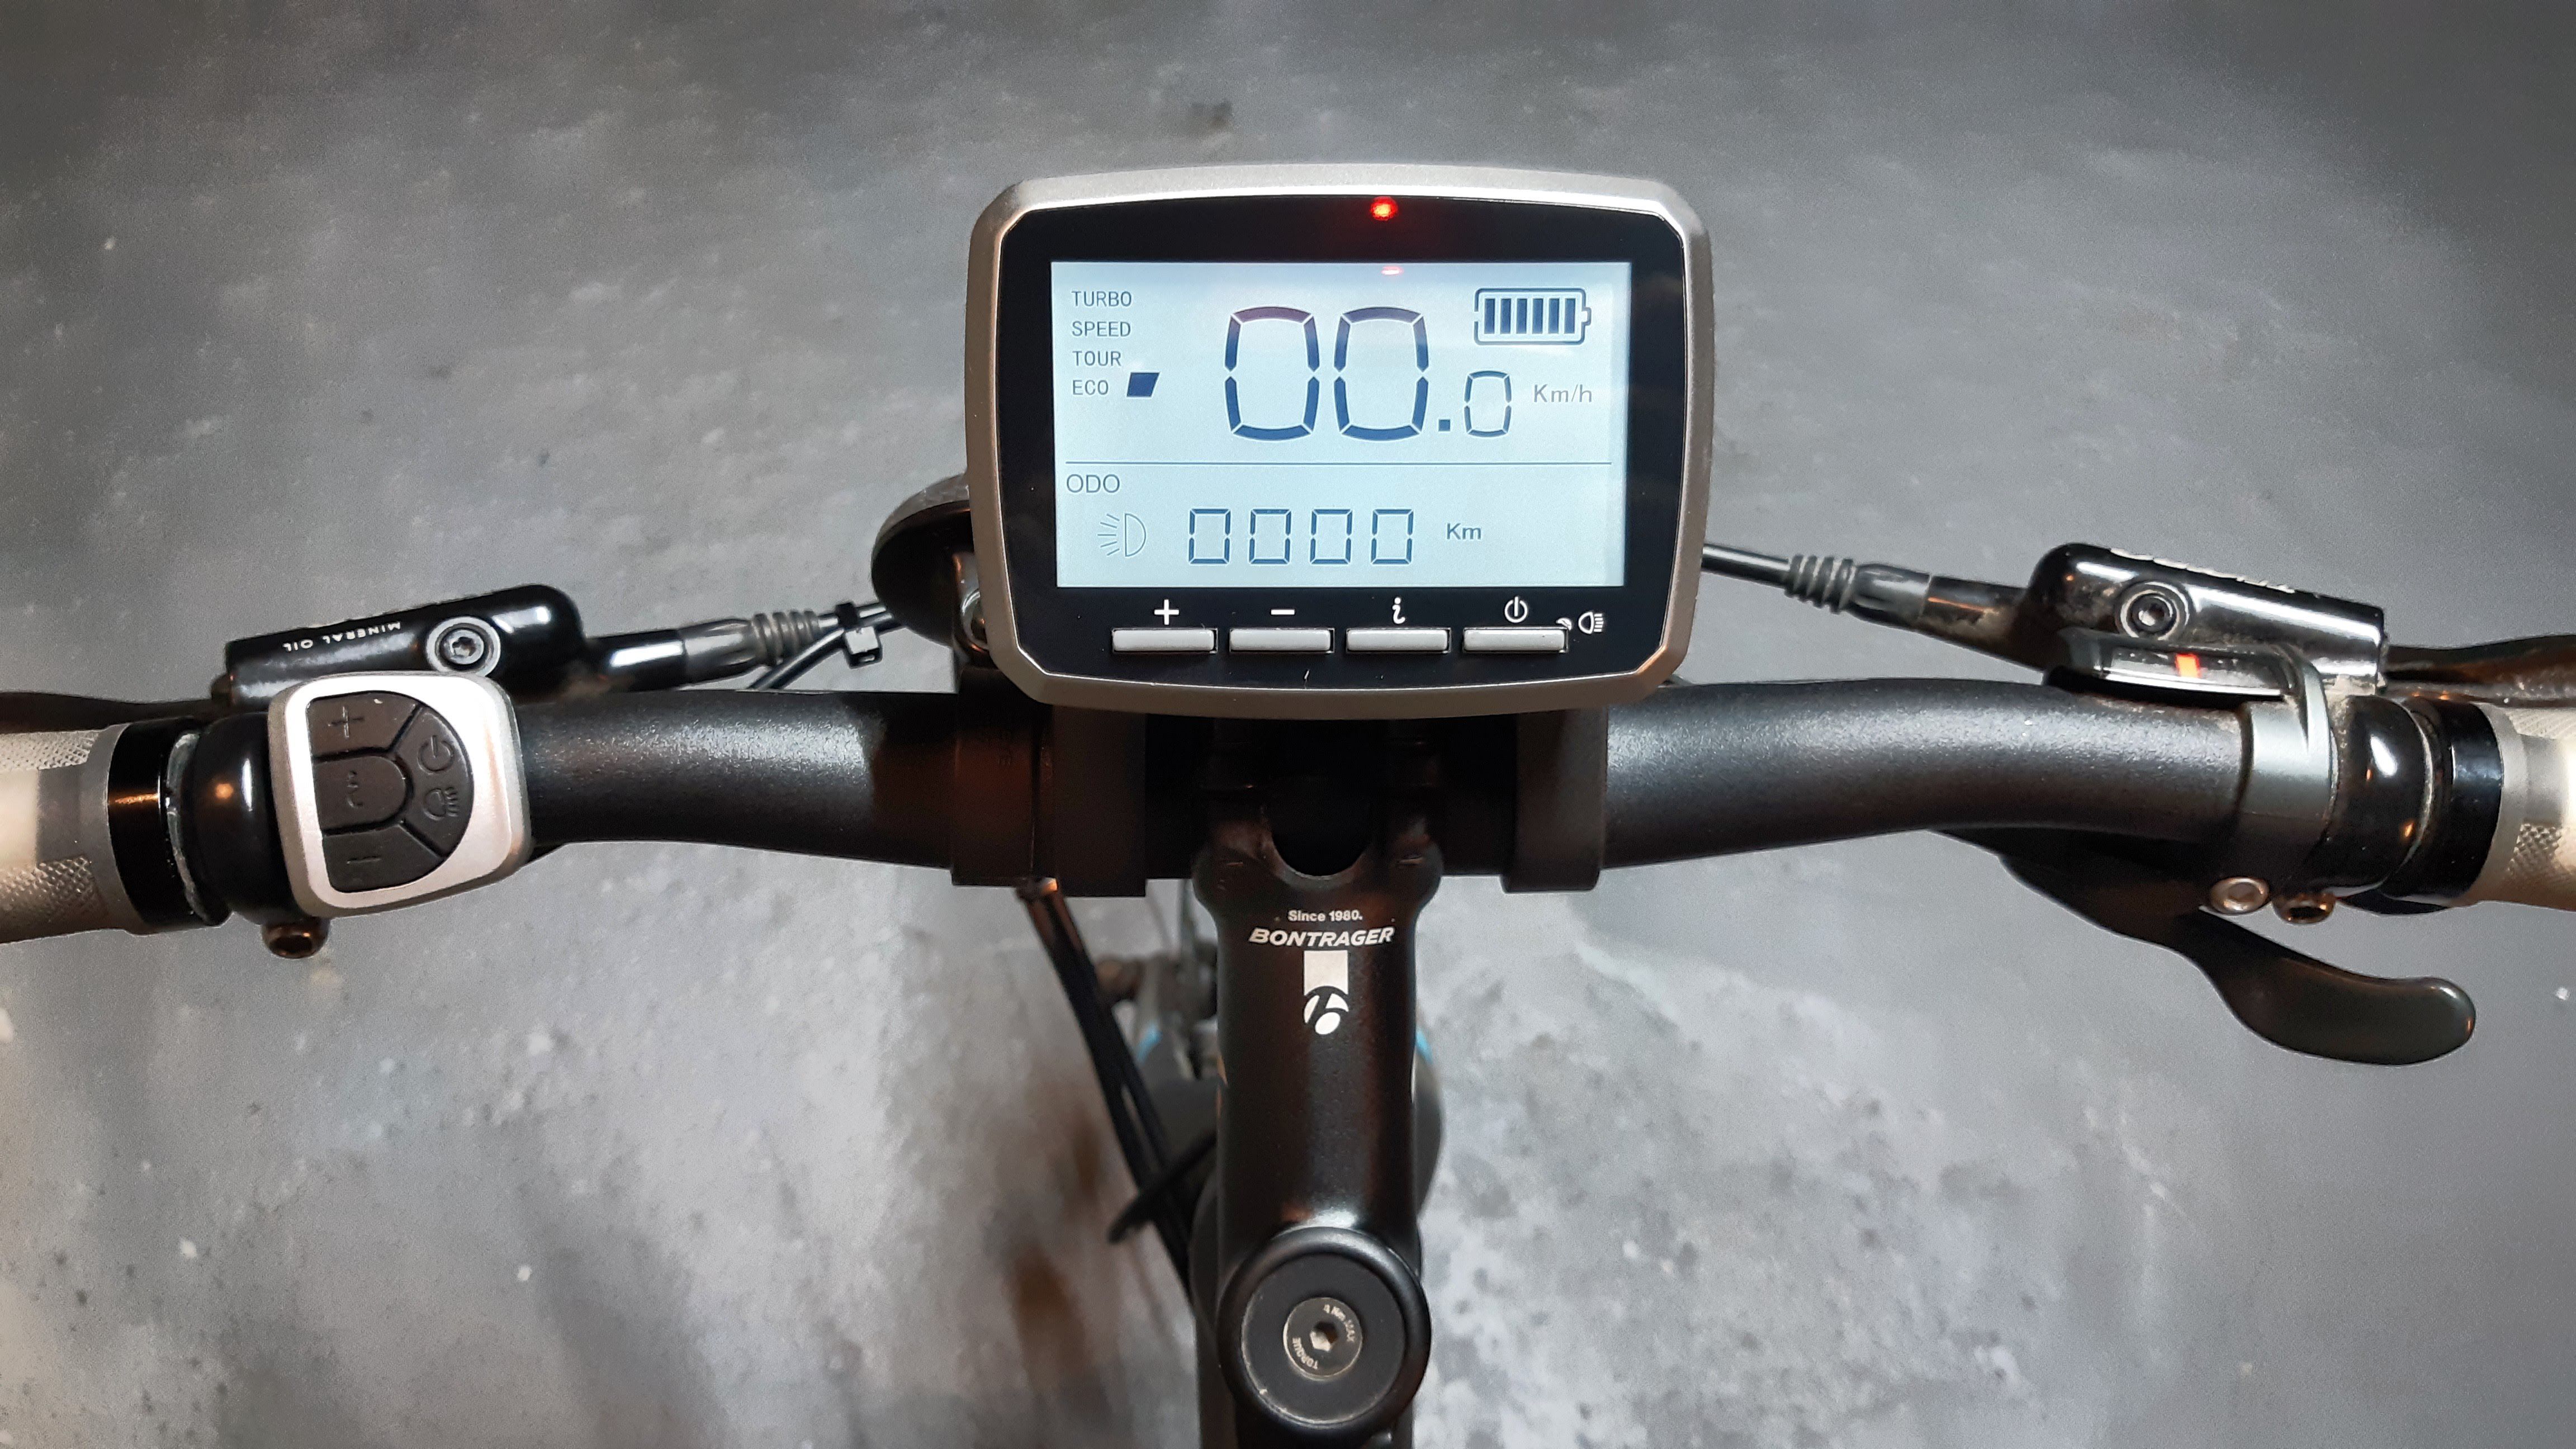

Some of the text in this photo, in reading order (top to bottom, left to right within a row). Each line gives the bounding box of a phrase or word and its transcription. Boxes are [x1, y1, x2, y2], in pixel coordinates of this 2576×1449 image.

[1072, 291, 1131, 306] TURBO
[1072, 321, 1131, 337] SPEED
[1072, 351, 1121, 366] TOUR
[1072, 380, 1109, 395] ECO
[1533, 384, 1592, 403] Km/h
[1066, 474, 1120, 493] ODO
[1447, 523, 1481, 540] Km
[282, 621, 401, 652] MINERAL OIL
[1288, 910, 1363, 922] Since 1980.
[1249, 927, 1395, 947] BONTRAGER
[1292, 1337, 1319, 1370] TORQUE
